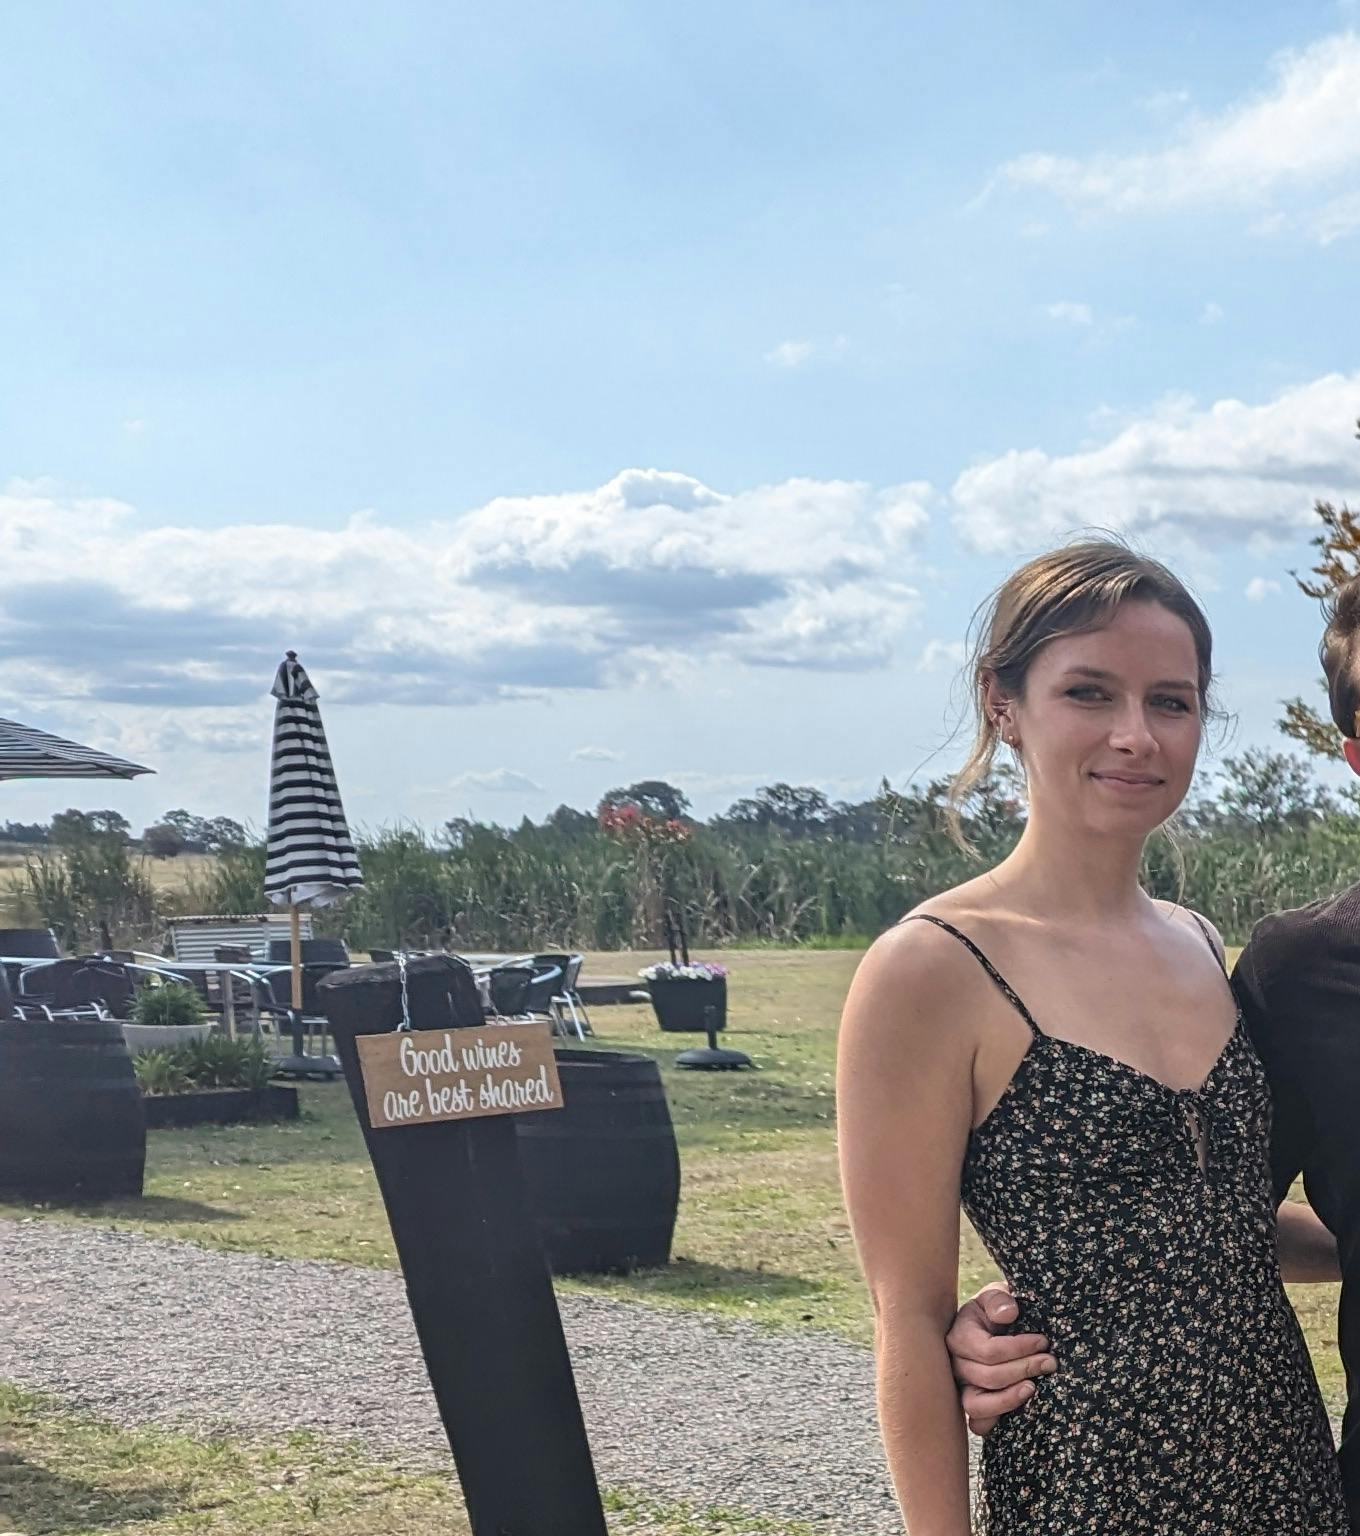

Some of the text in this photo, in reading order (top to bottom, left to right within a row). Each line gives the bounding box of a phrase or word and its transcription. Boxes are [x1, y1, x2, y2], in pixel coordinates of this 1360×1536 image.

[400, 1034, 522, 1077] Good wines
[383, 1064, 554, 1121] are best shared
